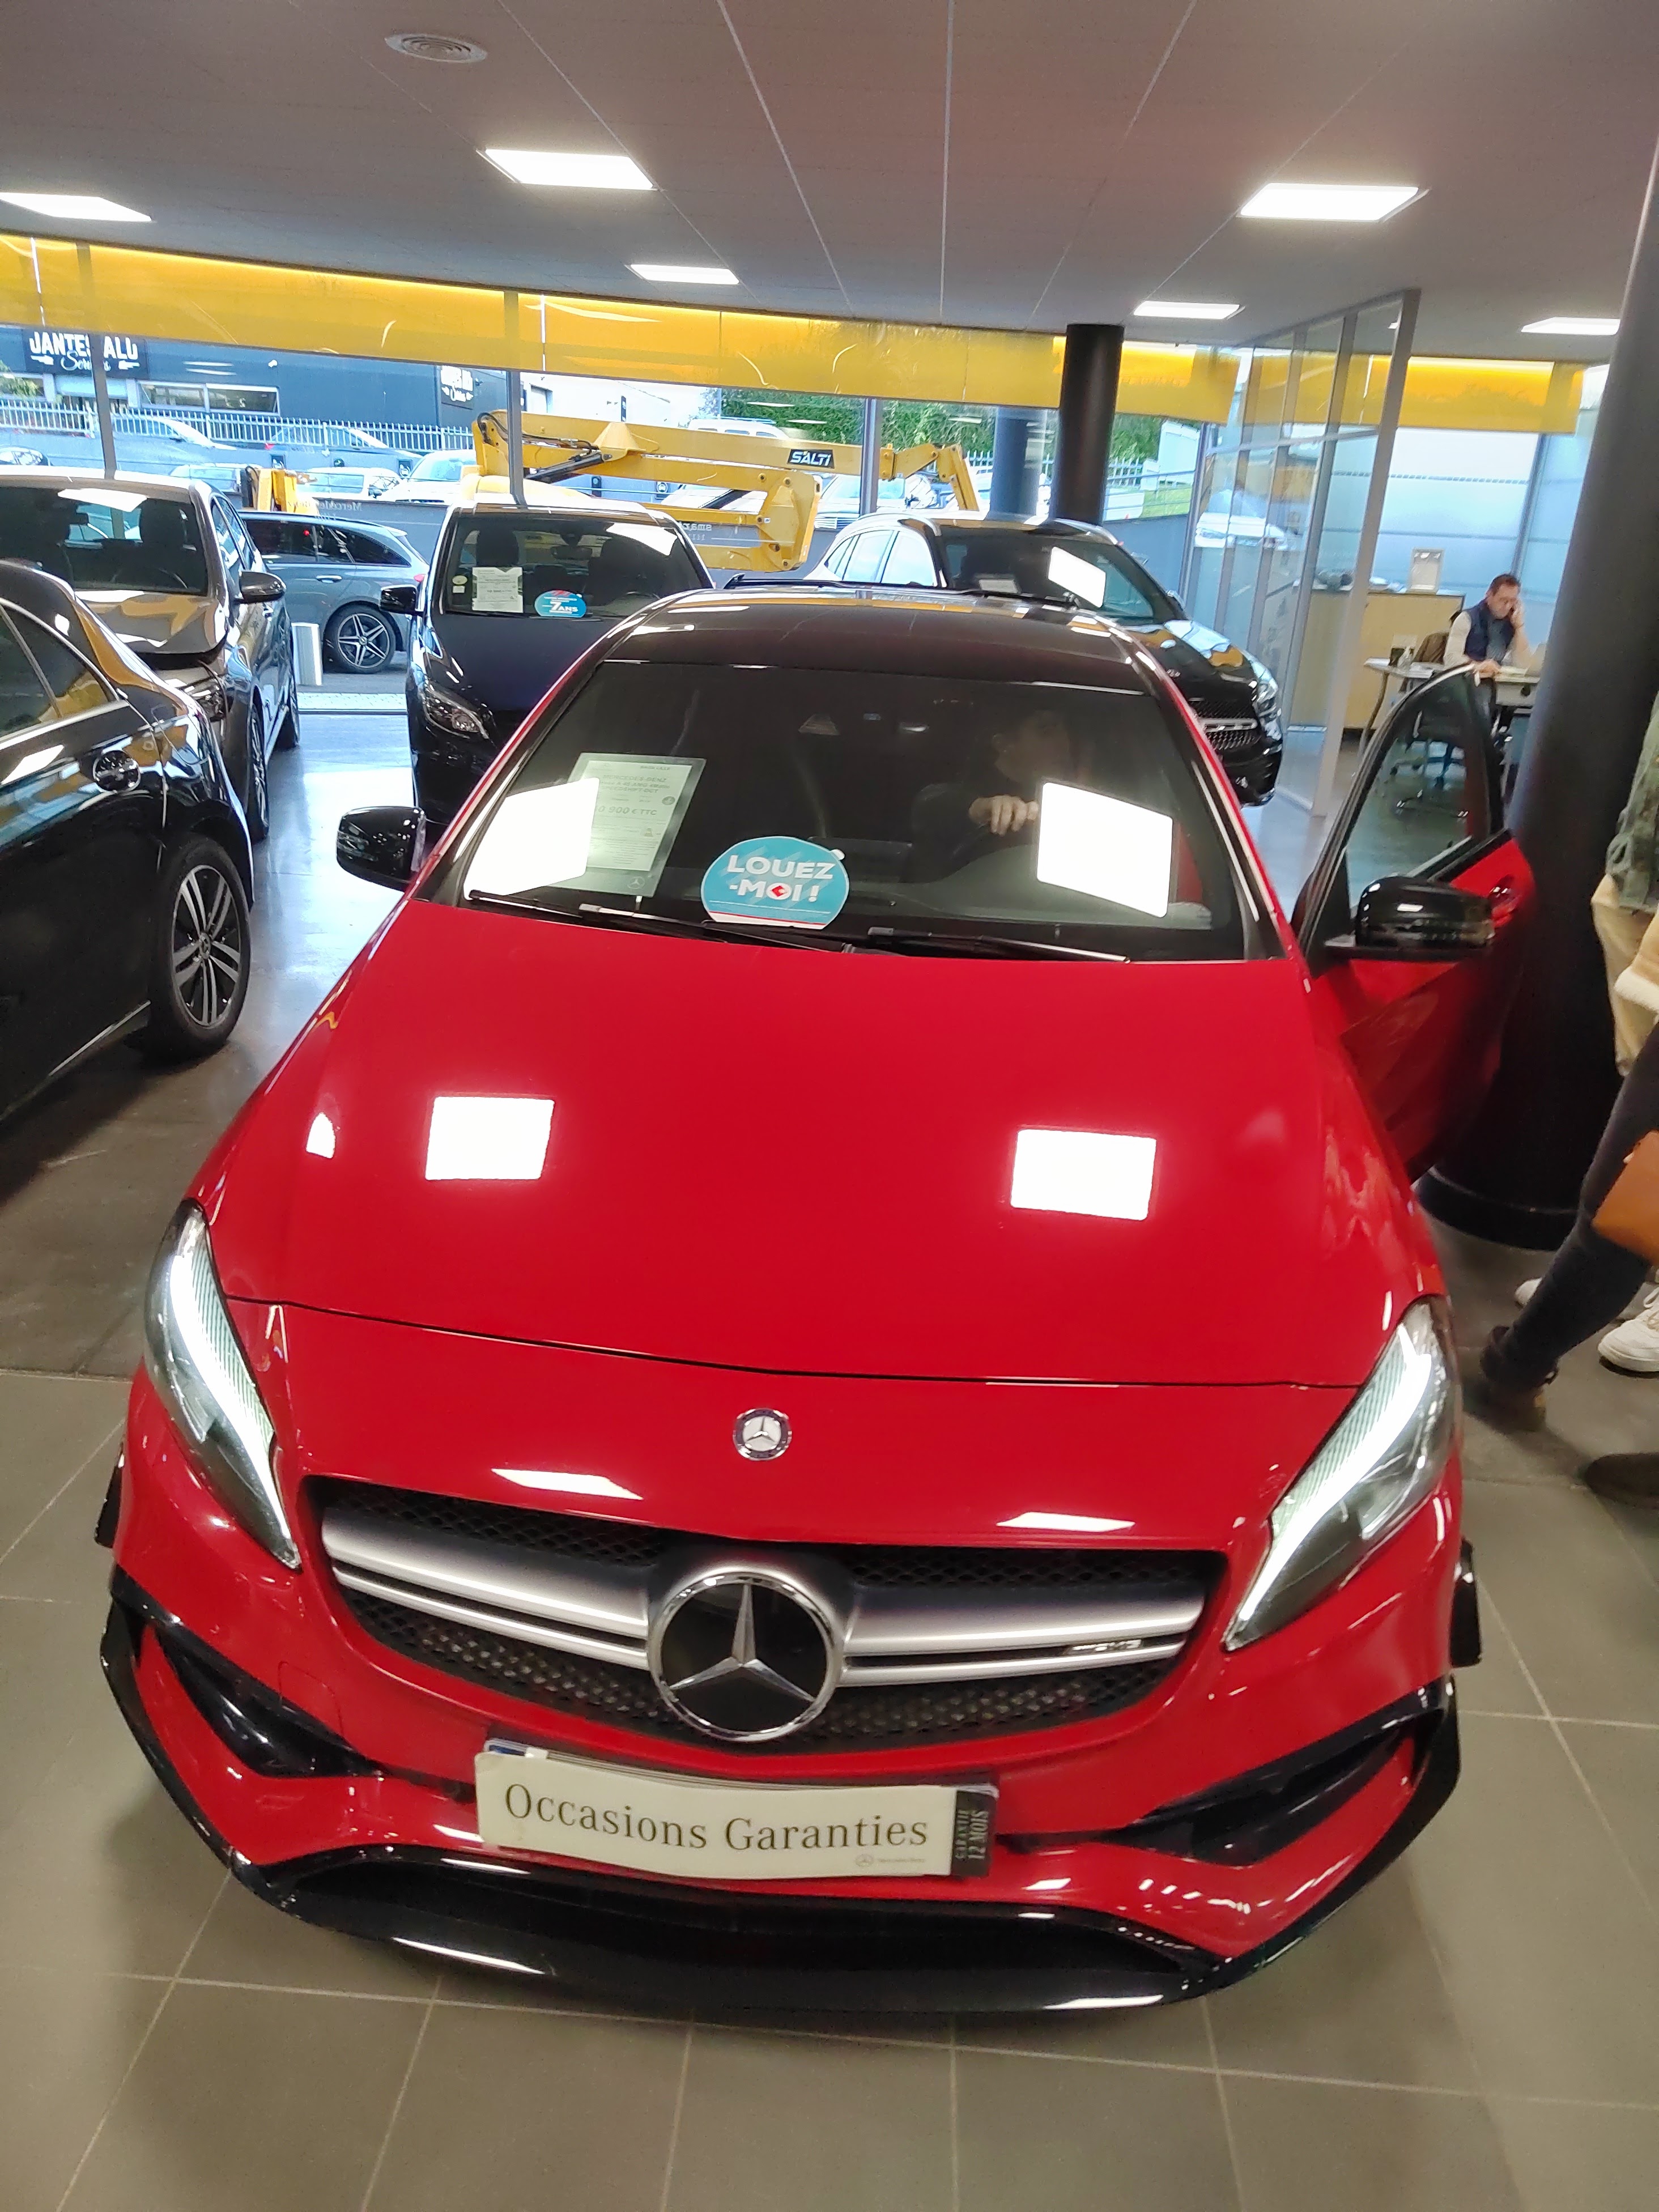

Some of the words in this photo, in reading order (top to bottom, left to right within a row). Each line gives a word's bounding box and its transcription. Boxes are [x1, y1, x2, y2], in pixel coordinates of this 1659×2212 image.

[104, 336, 138, 360] ALU
[727, 855, 836, 879] LOUEZ
[505, 1783, 708, 1849] Occasions
[724, 1815, 928, 1851] Garanties
[968, 1810, 989, 1844] MOIS
[968, 1846, 986, 1859] 12
